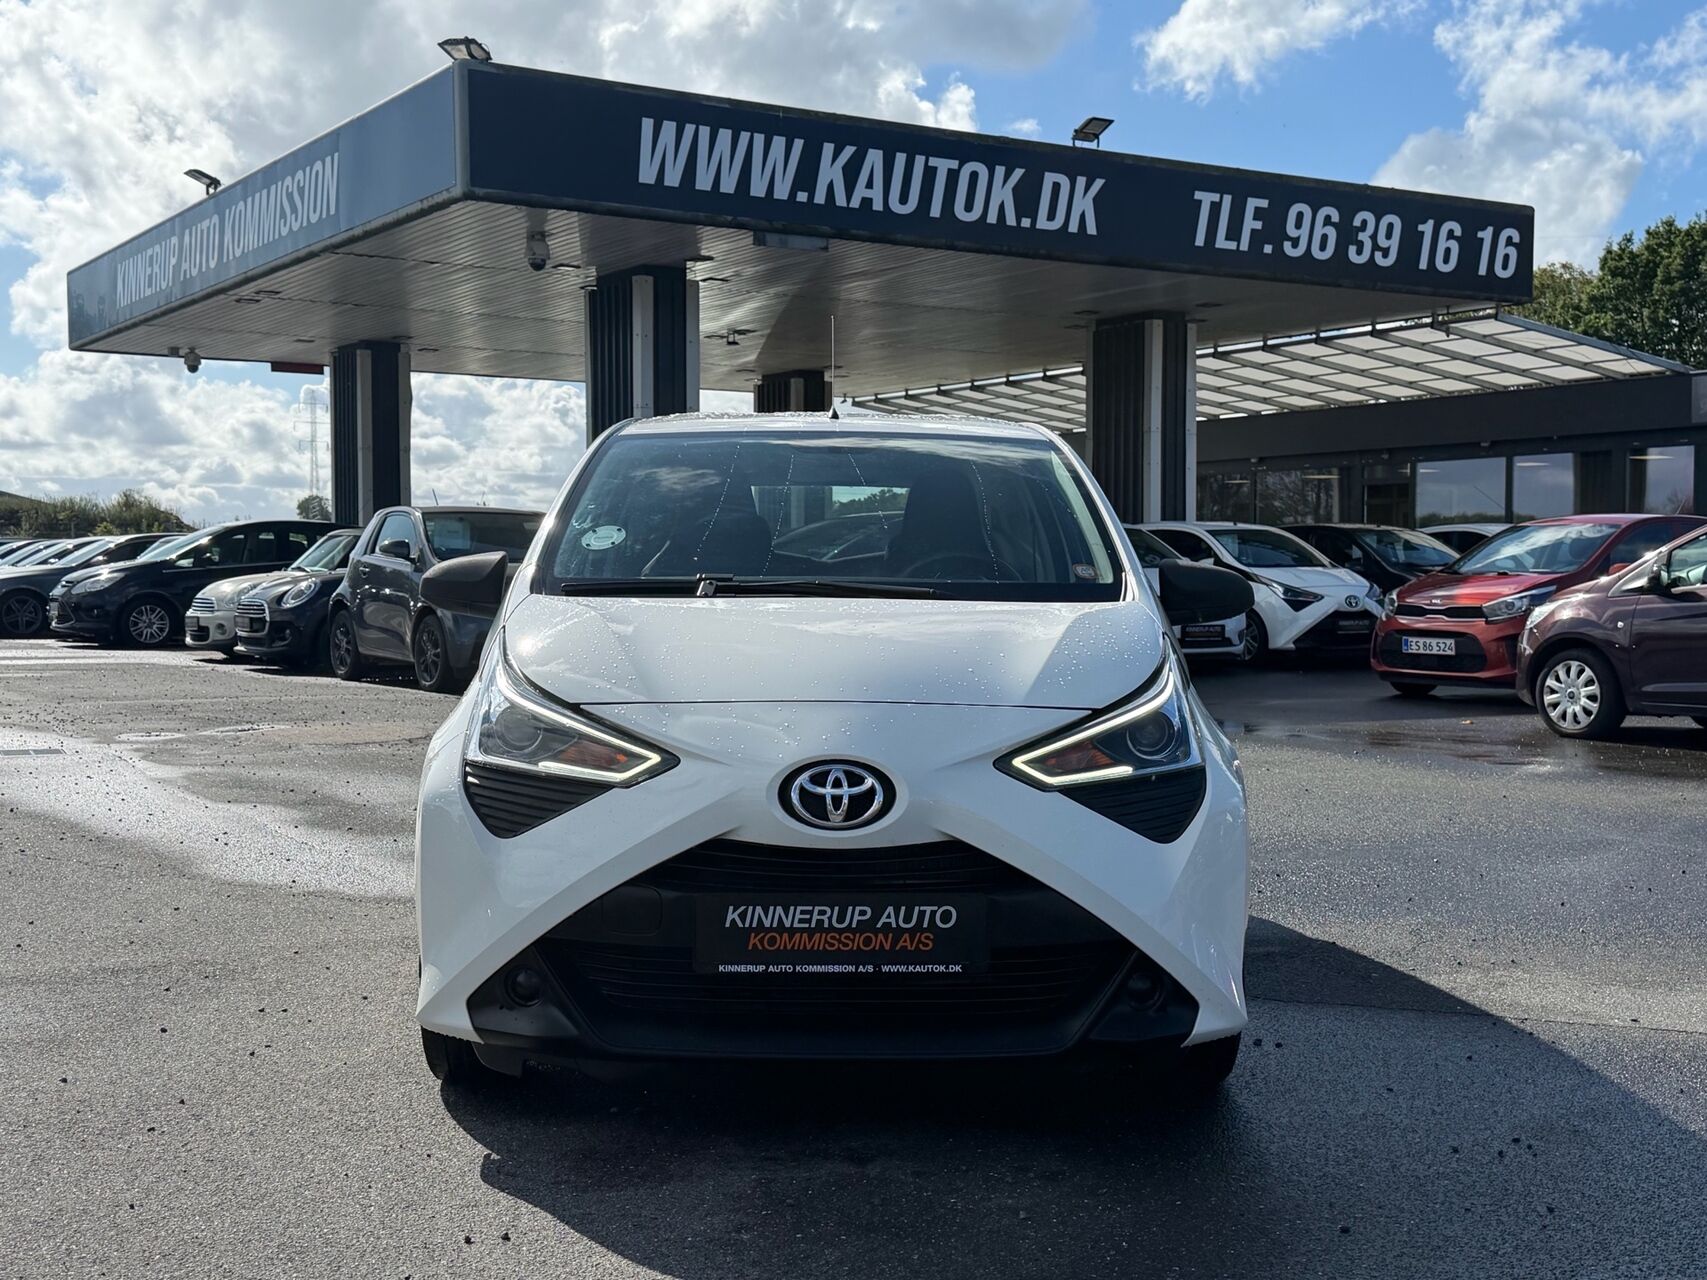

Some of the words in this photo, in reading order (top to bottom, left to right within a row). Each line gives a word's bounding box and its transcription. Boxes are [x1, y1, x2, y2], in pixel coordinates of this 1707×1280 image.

[638, 117, 1106, 236] WWW.KAUTOK.DK
[116, 235, 179, 309] KINNERUP
[180, 213, 220, 281] AUTO
[223, 152, 340, 263] KOMMISSION
[1193, 190, 1273, 254] TLF.
[1283, 202, 1340, 261] 96
[1347, 210, 1402, 268] 39
[1417, 219, 1463, 274] 16
[1476, 226, 1521, 280] 16
[1409, 640, 1420, 651] ES
[1422, 640, 1433, 652] 86
[1436, 641, 1453, 652] 524
[724, 905, 872, 929] KINNERUP
[876, 905, 957, 929] AUTO
[747, 932, 893, 951] KOMMISSION
[895, 932, 934, 951] A/S
[718, 964, 766, 973] KINNERUP
[767, 964, 793, 973] AUTO
[795, 964, 856, 973] KOMMISSION
[857, 964, 874, 973] A/S
[881, 964, 963, 973] WWW.KAUTOK.DK
